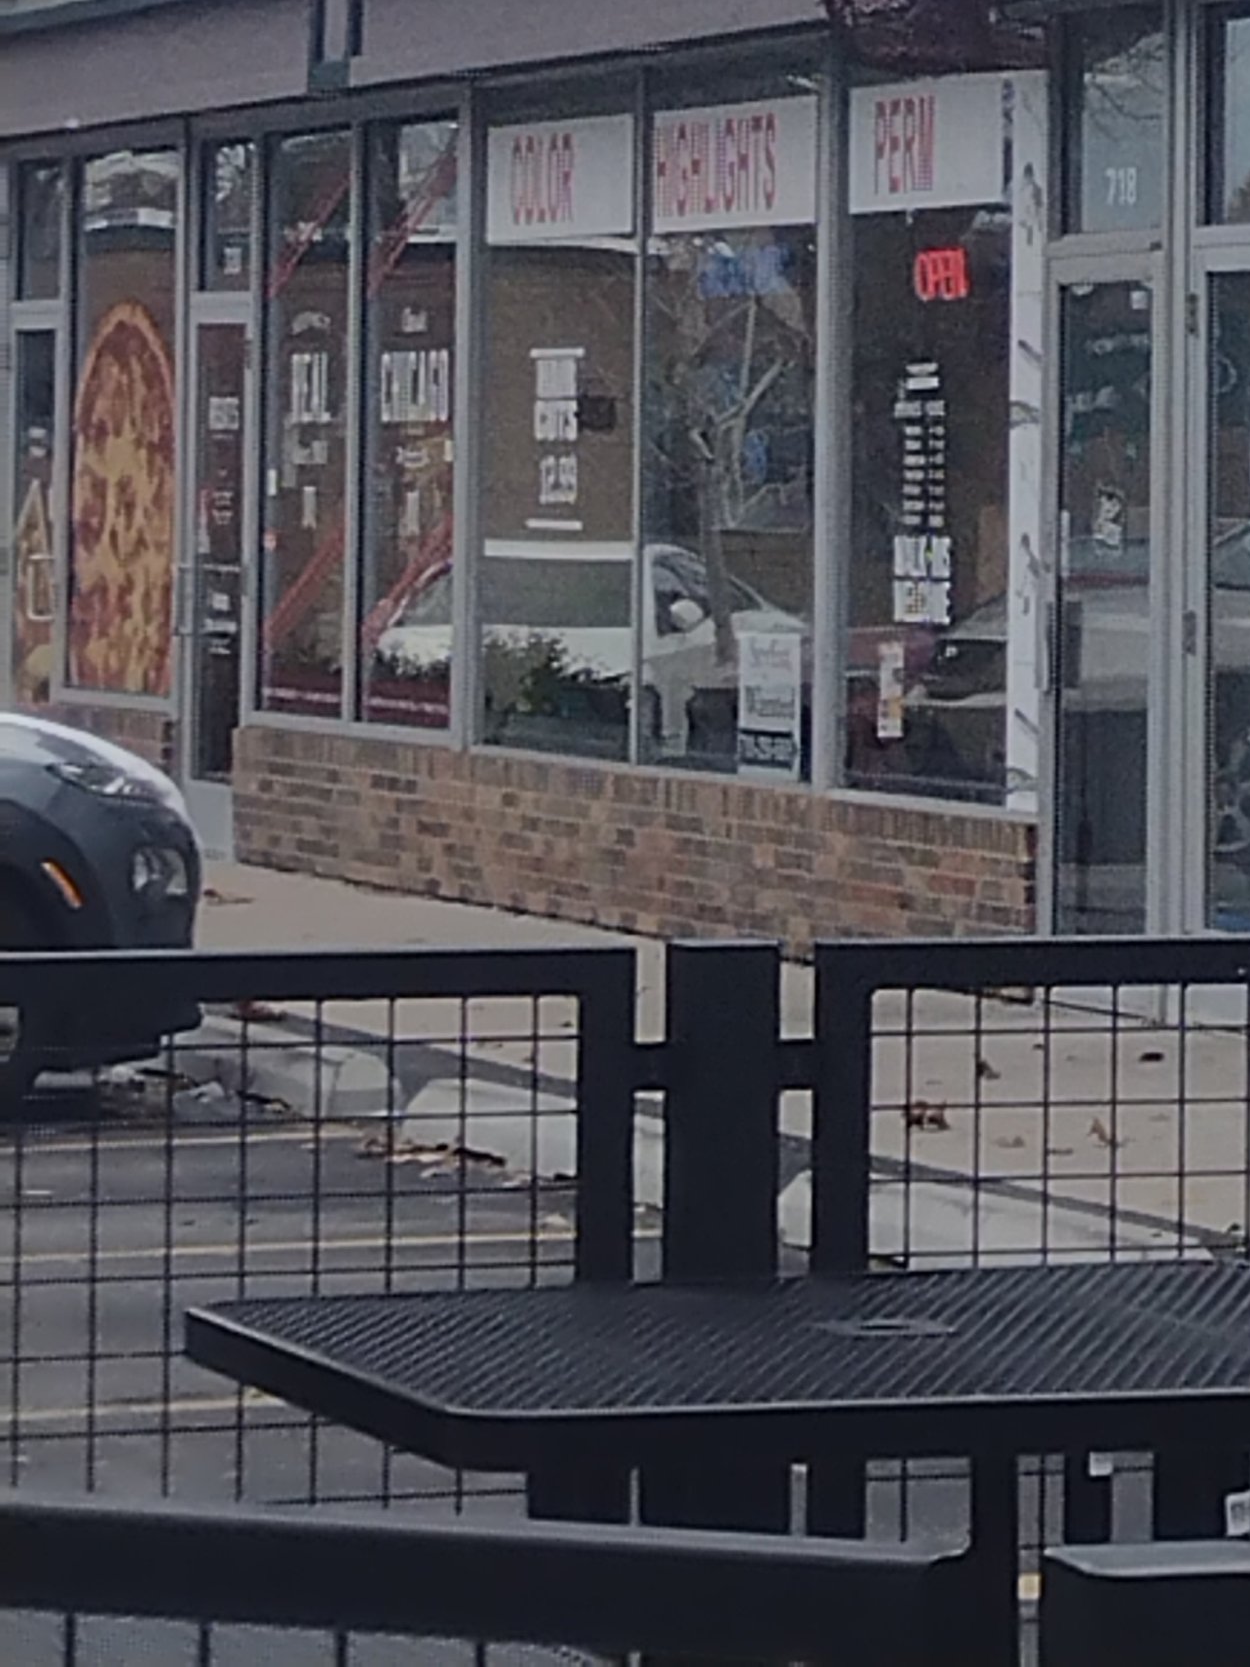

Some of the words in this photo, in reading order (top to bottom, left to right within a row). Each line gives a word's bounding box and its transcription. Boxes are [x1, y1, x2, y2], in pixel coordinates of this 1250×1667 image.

[511, 133, 574, 226] COLOR
[656, 112, 777, 218] HIGHLIGHTS
[873, 95, 937, 196] PERM
[1104, 167, 1138, 206] 718
[913, 248, 968, 301] OPEN
